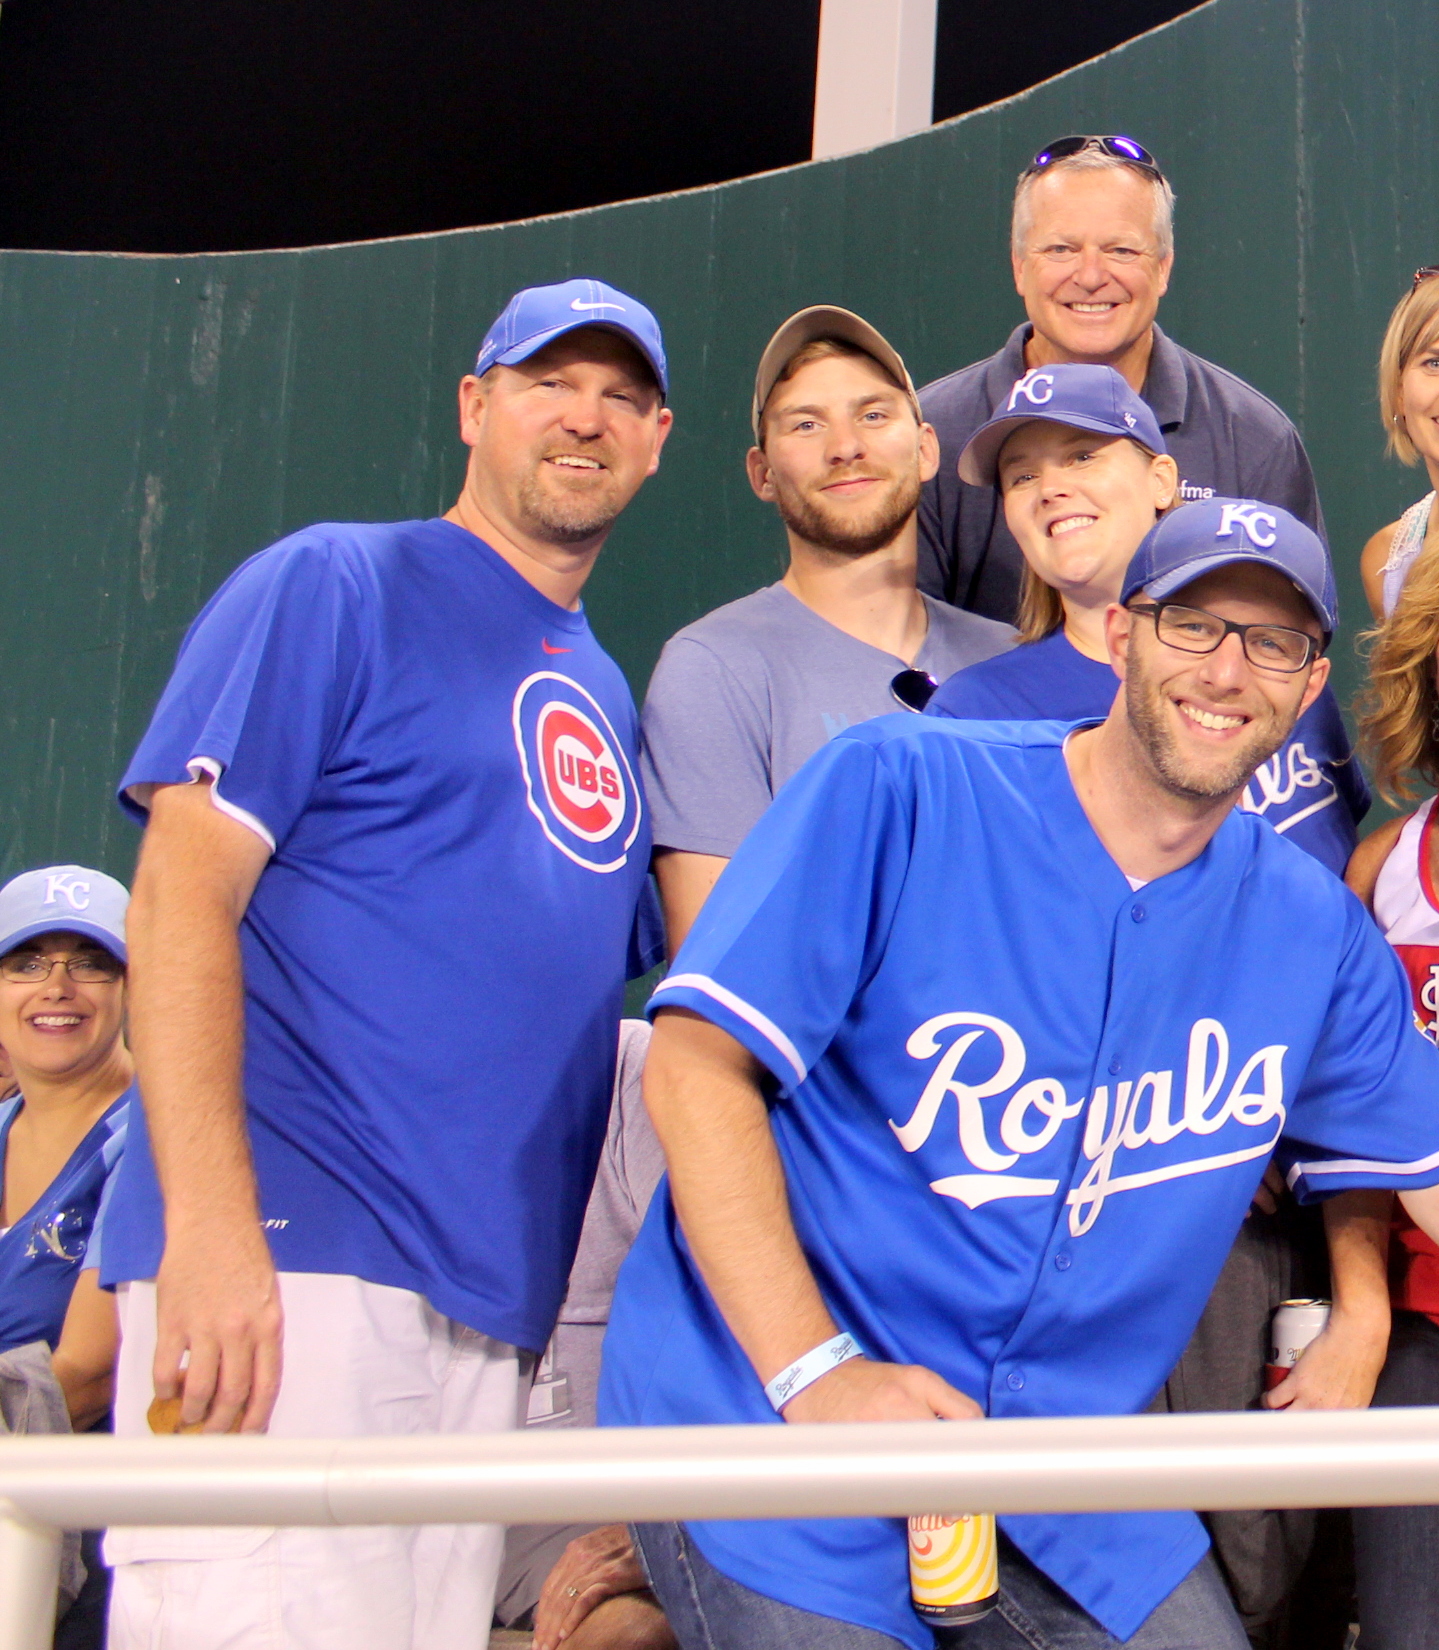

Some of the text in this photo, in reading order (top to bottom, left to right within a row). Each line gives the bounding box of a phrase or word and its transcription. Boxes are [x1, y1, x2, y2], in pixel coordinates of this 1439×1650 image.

[1007, 368, 1054, 411] KC
[1216, 504, 1276, 547] KC
[543, 710, 621, 833] CUBS
[44, 873, 90, 910] KC
[888, 1011, 1288, 1237] Royals
